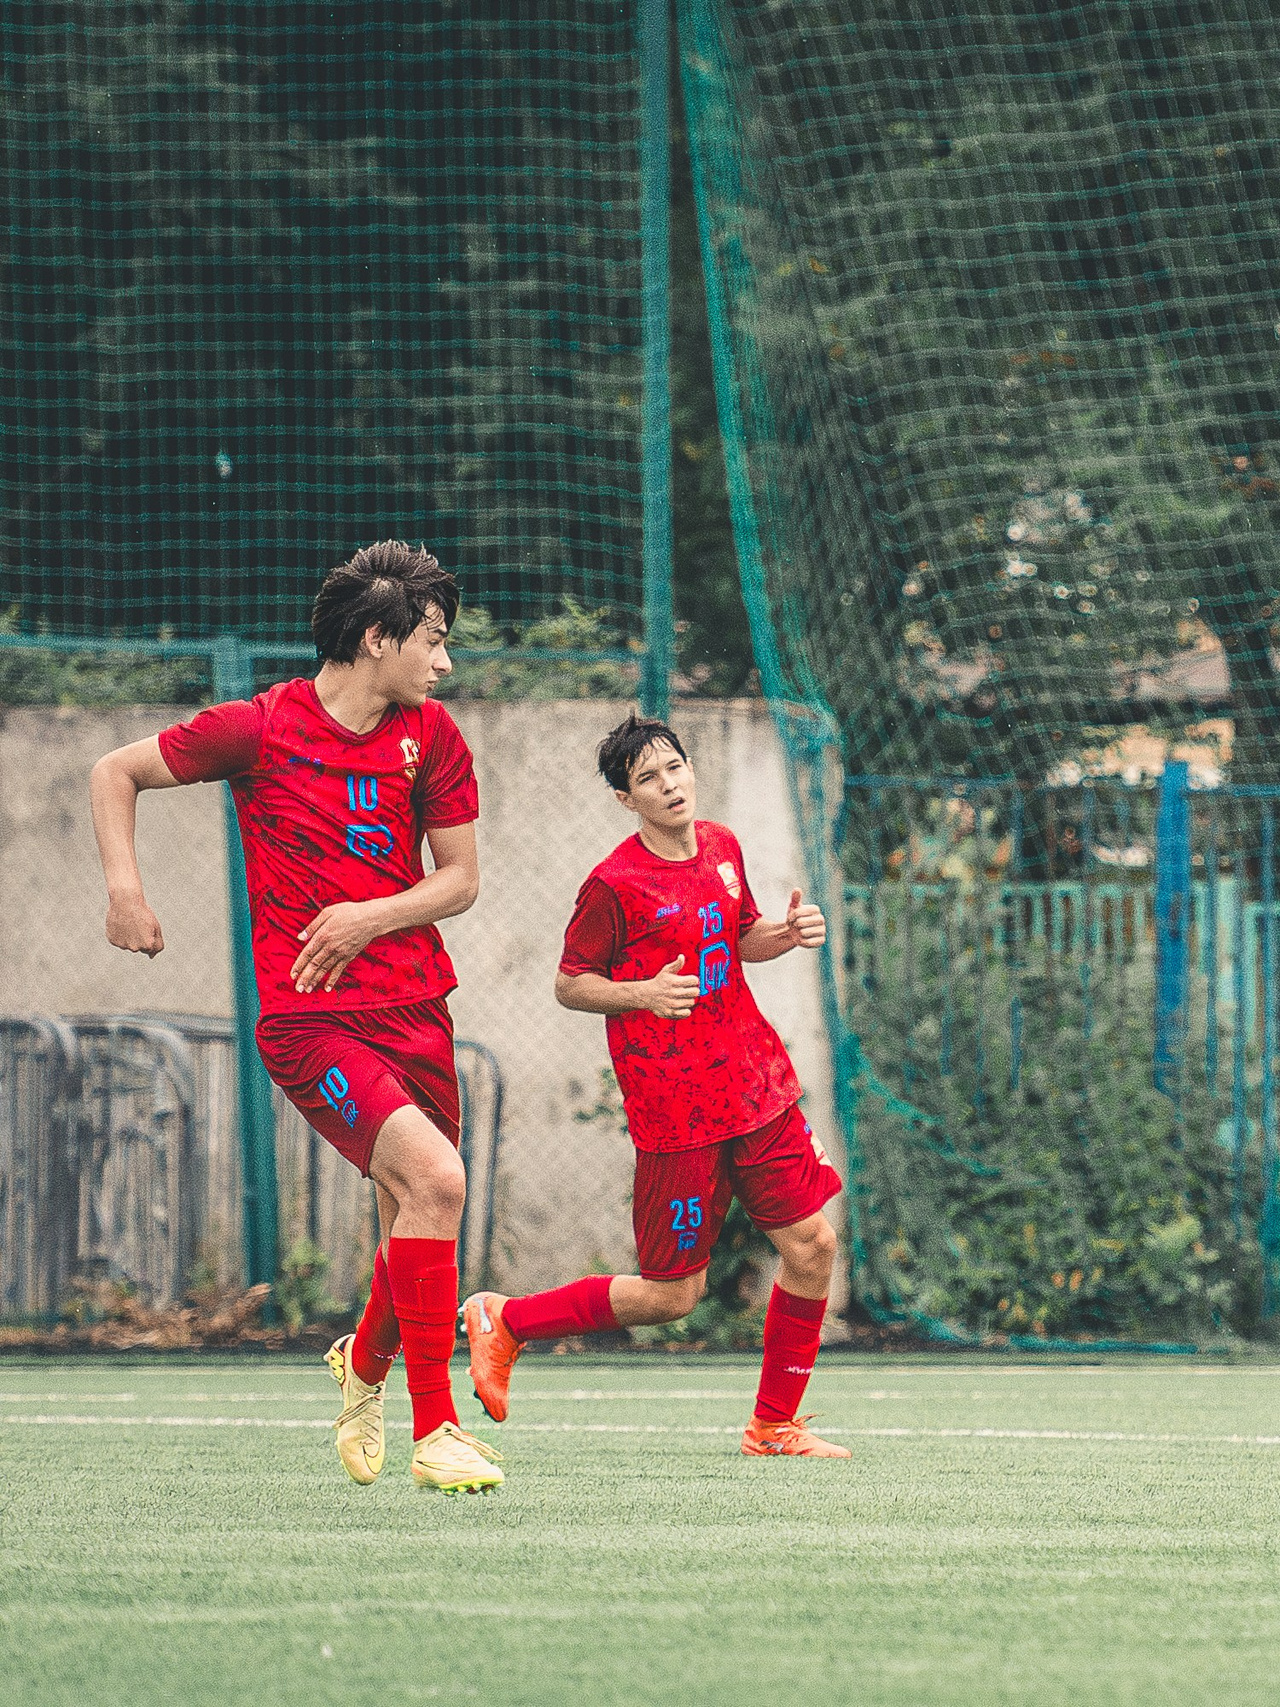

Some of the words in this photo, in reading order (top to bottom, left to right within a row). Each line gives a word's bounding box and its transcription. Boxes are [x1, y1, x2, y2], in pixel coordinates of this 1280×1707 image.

[346, 774, 378, 811] 10
[698, 901, 723, 939] 25
[317, 1066, 349, 1112] 10
[669, 1195, 702, 1231] 25
